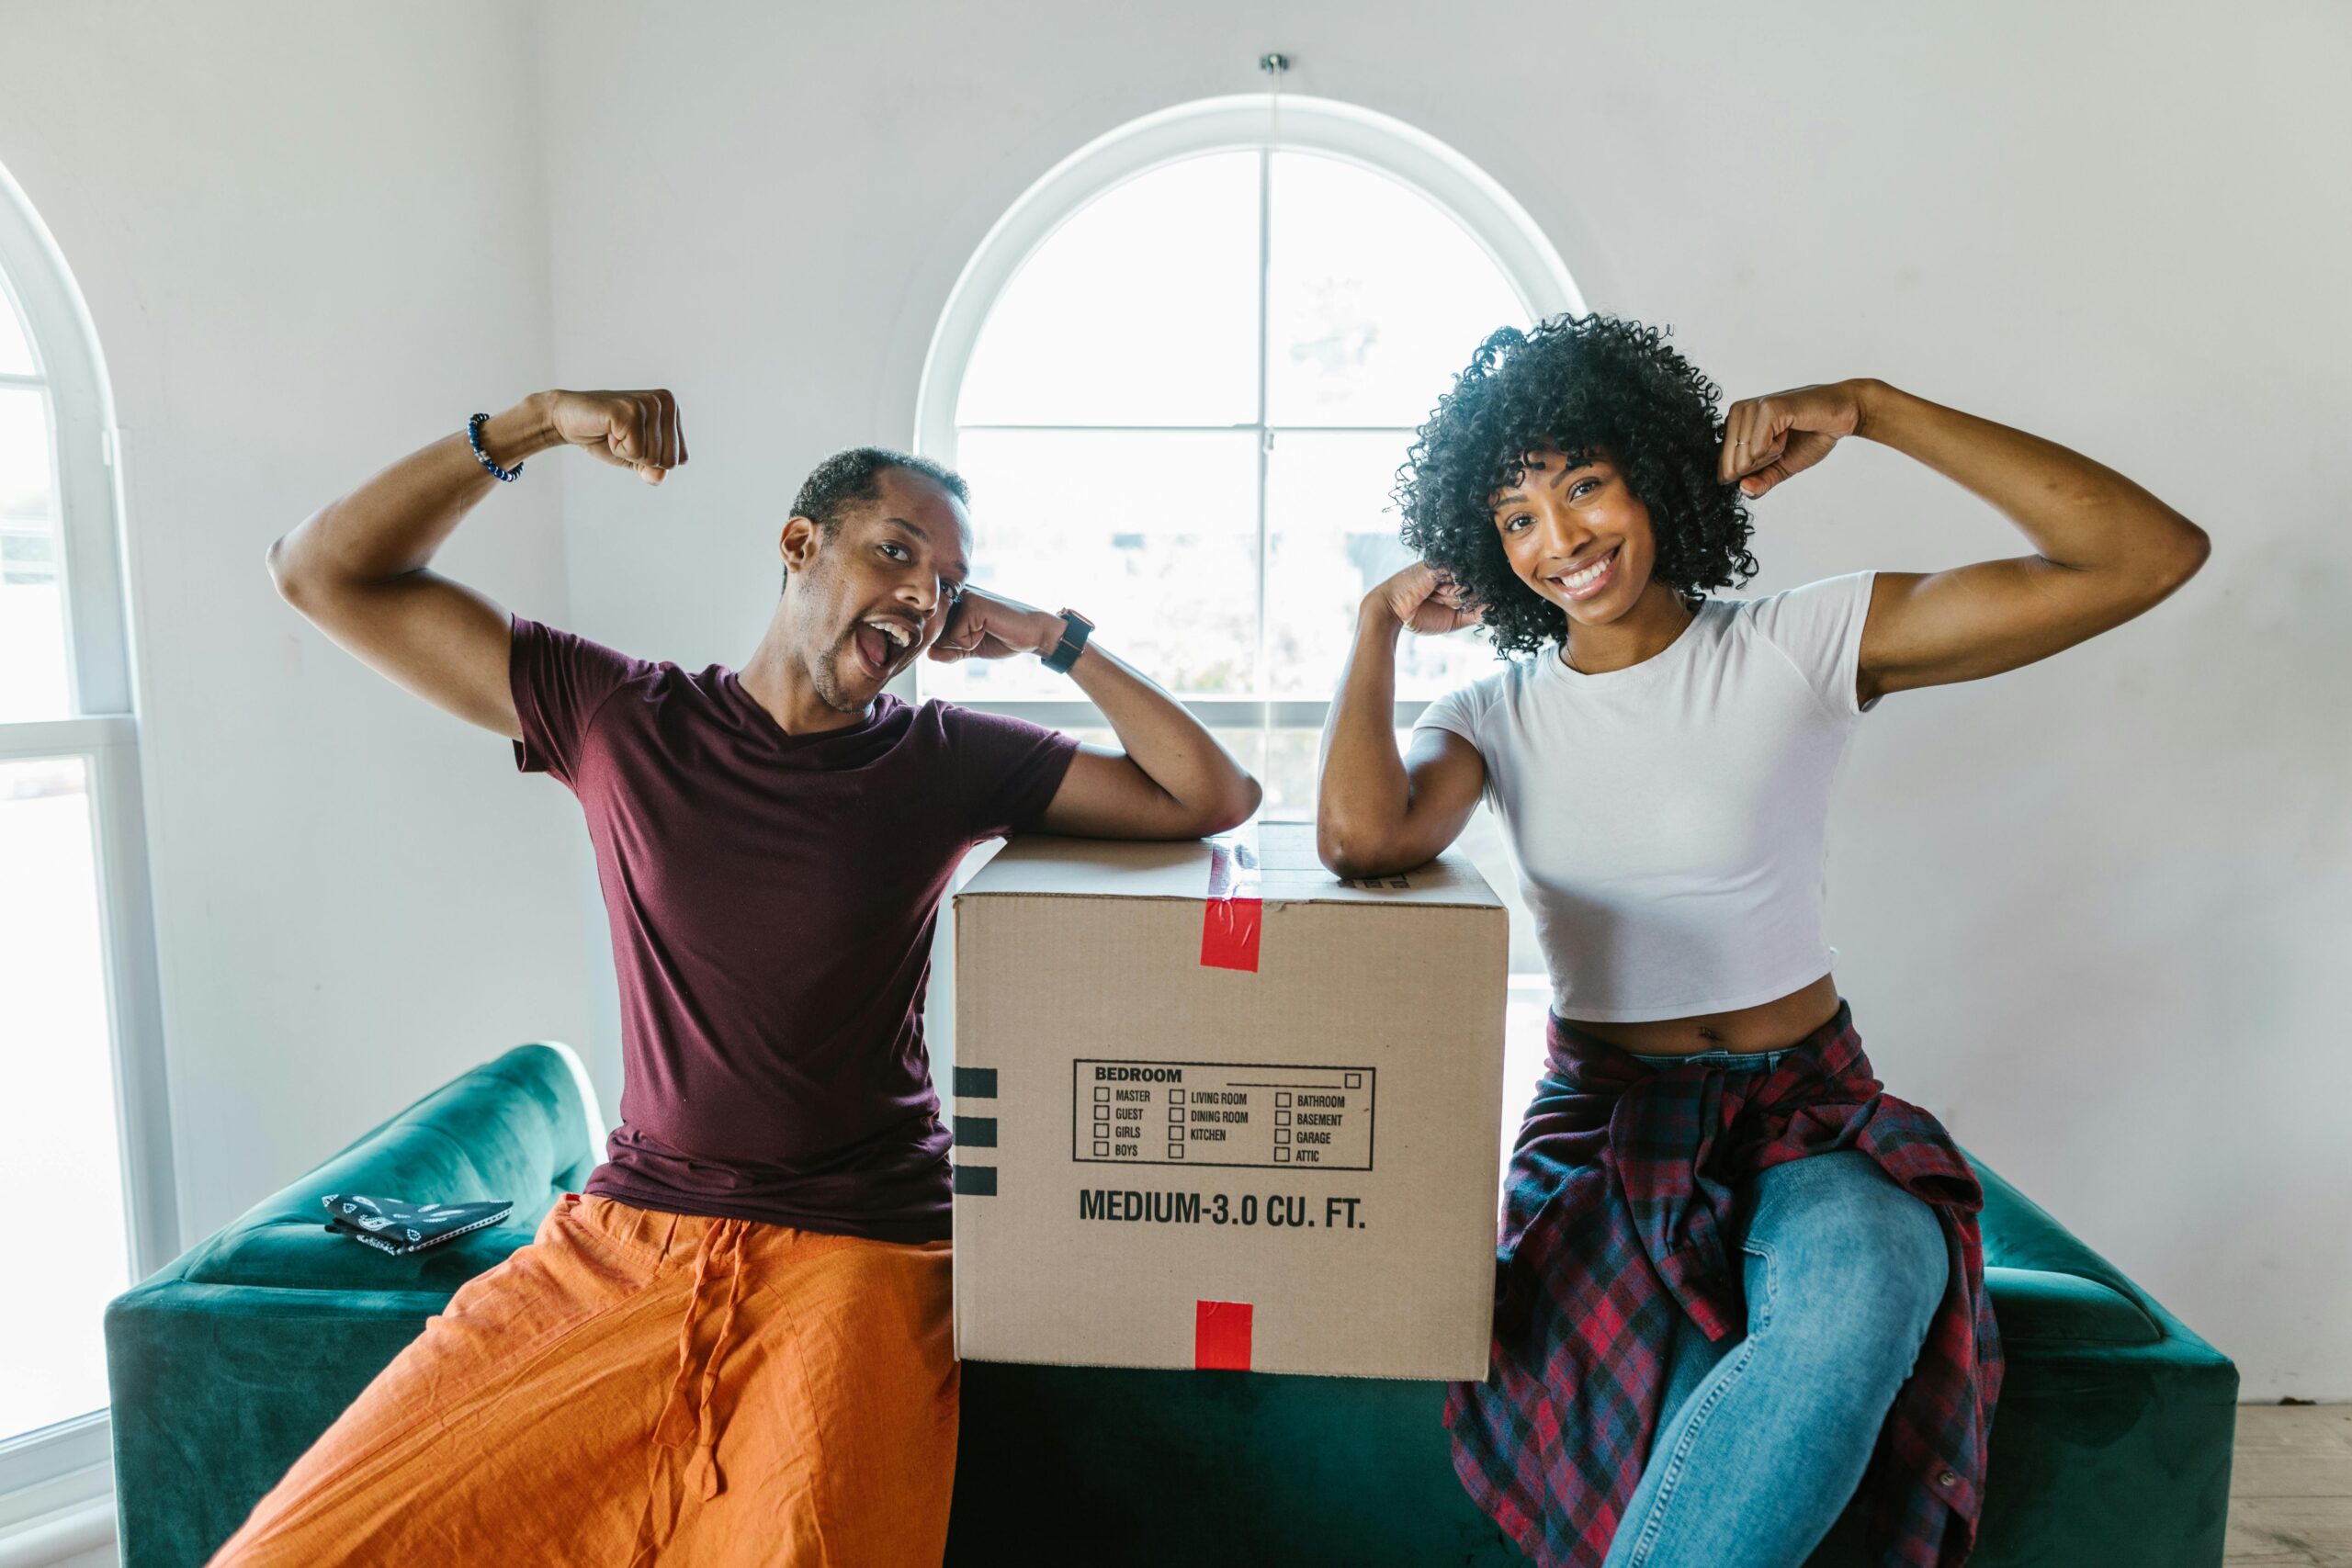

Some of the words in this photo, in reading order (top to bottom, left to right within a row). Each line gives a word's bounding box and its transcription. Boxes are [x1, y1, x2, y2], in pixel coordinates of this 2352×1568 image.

[1095, 1066, 1182, 1083] BEDROOM
[1116, 1089, 1150, 1102] MASTER
[1192, 1092, 1219, 1104] LIVING
[1221, 1092, 1247, 1105] ROOM
[1298, 1095, 1345, 1108] BATHROOM
[1116, 1108, 1143, 1120] GUEST
[1192, 1111, 1220, 1122] DINING
[1223, 1111, 1248, 1123] ROOM
[1297, 1113, 1342, 1126] BASEMENT
[1115, 1126, 1140, 1138] GIRLS
[1191, 1129, 1226, 1141] KITCHEN
[1296, 1132, 1330, 1144] GARAGE
[1115, 1145, 1137, 1156] BOYS
[1296, 1150, 1319, 1162] ATTIC
[1080, 1190, 1257, 1225] MEDIUM-3.0
[1267, 1195, 1314, 1227] CU.
[1326, 1198, 1365, 1228] FT.
